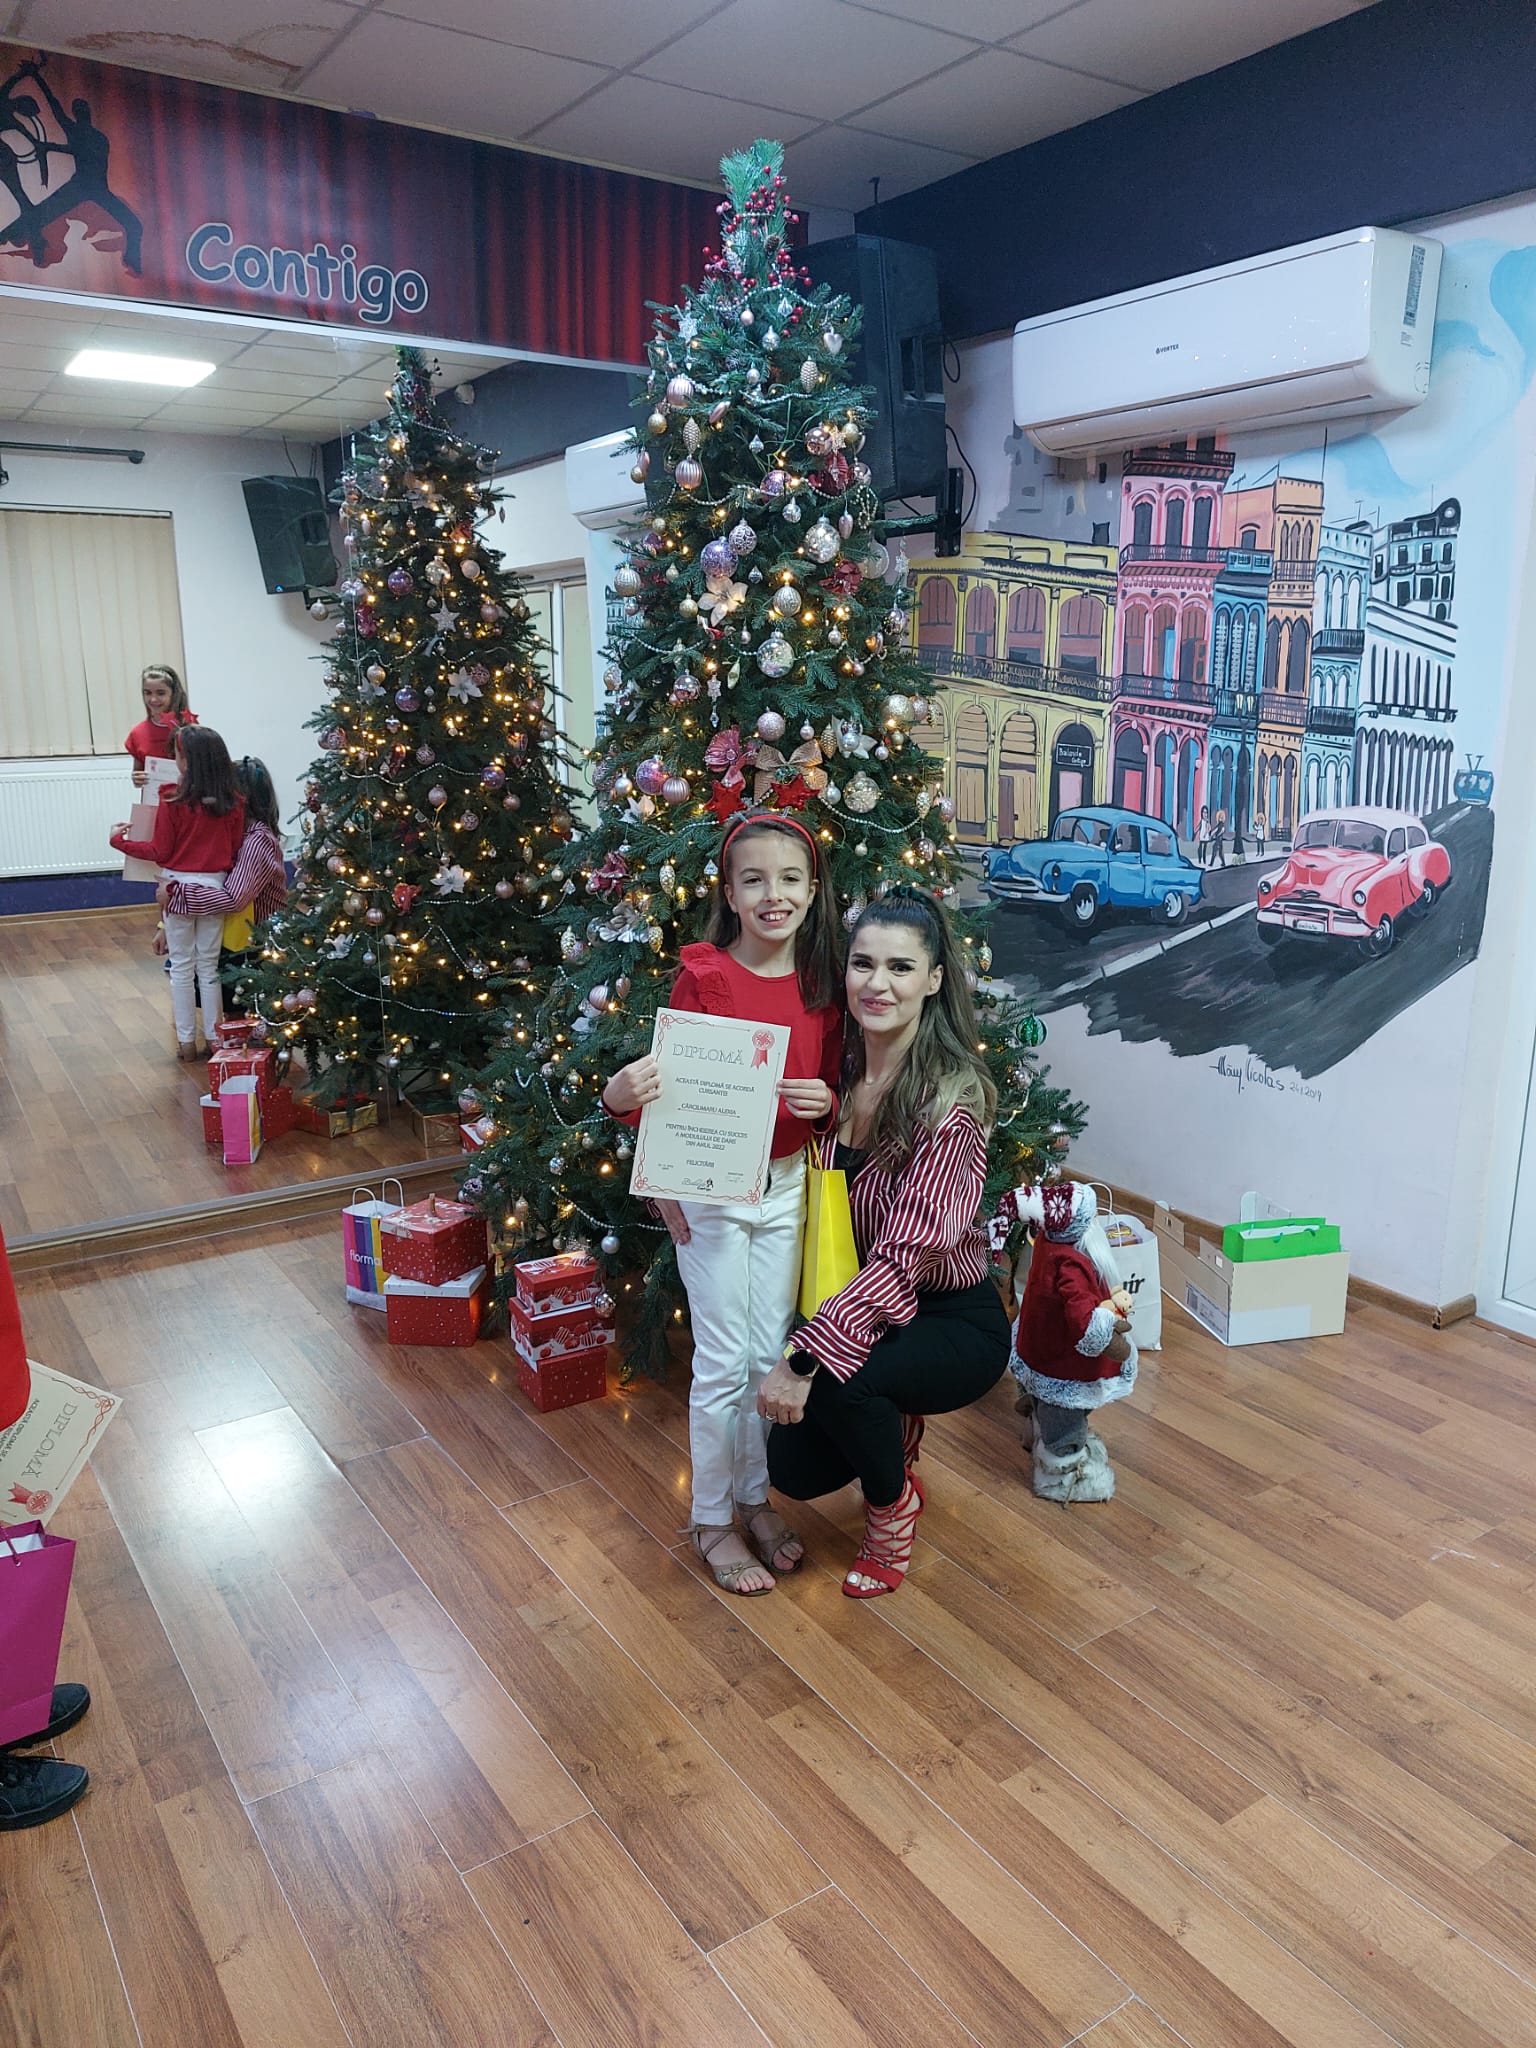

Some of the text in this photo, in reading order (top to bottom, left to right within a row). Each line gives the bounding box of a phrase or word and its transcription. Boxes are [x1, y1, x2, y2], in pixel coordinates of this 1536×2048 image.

[186, 223, 428, 324] Contigo
[672, 1043, 744, 1065] DIPLOMĂ
[665, 1123, 687, 1131] PENTRU
[21, 1402, 78, 1478] DIPLOMĂ
